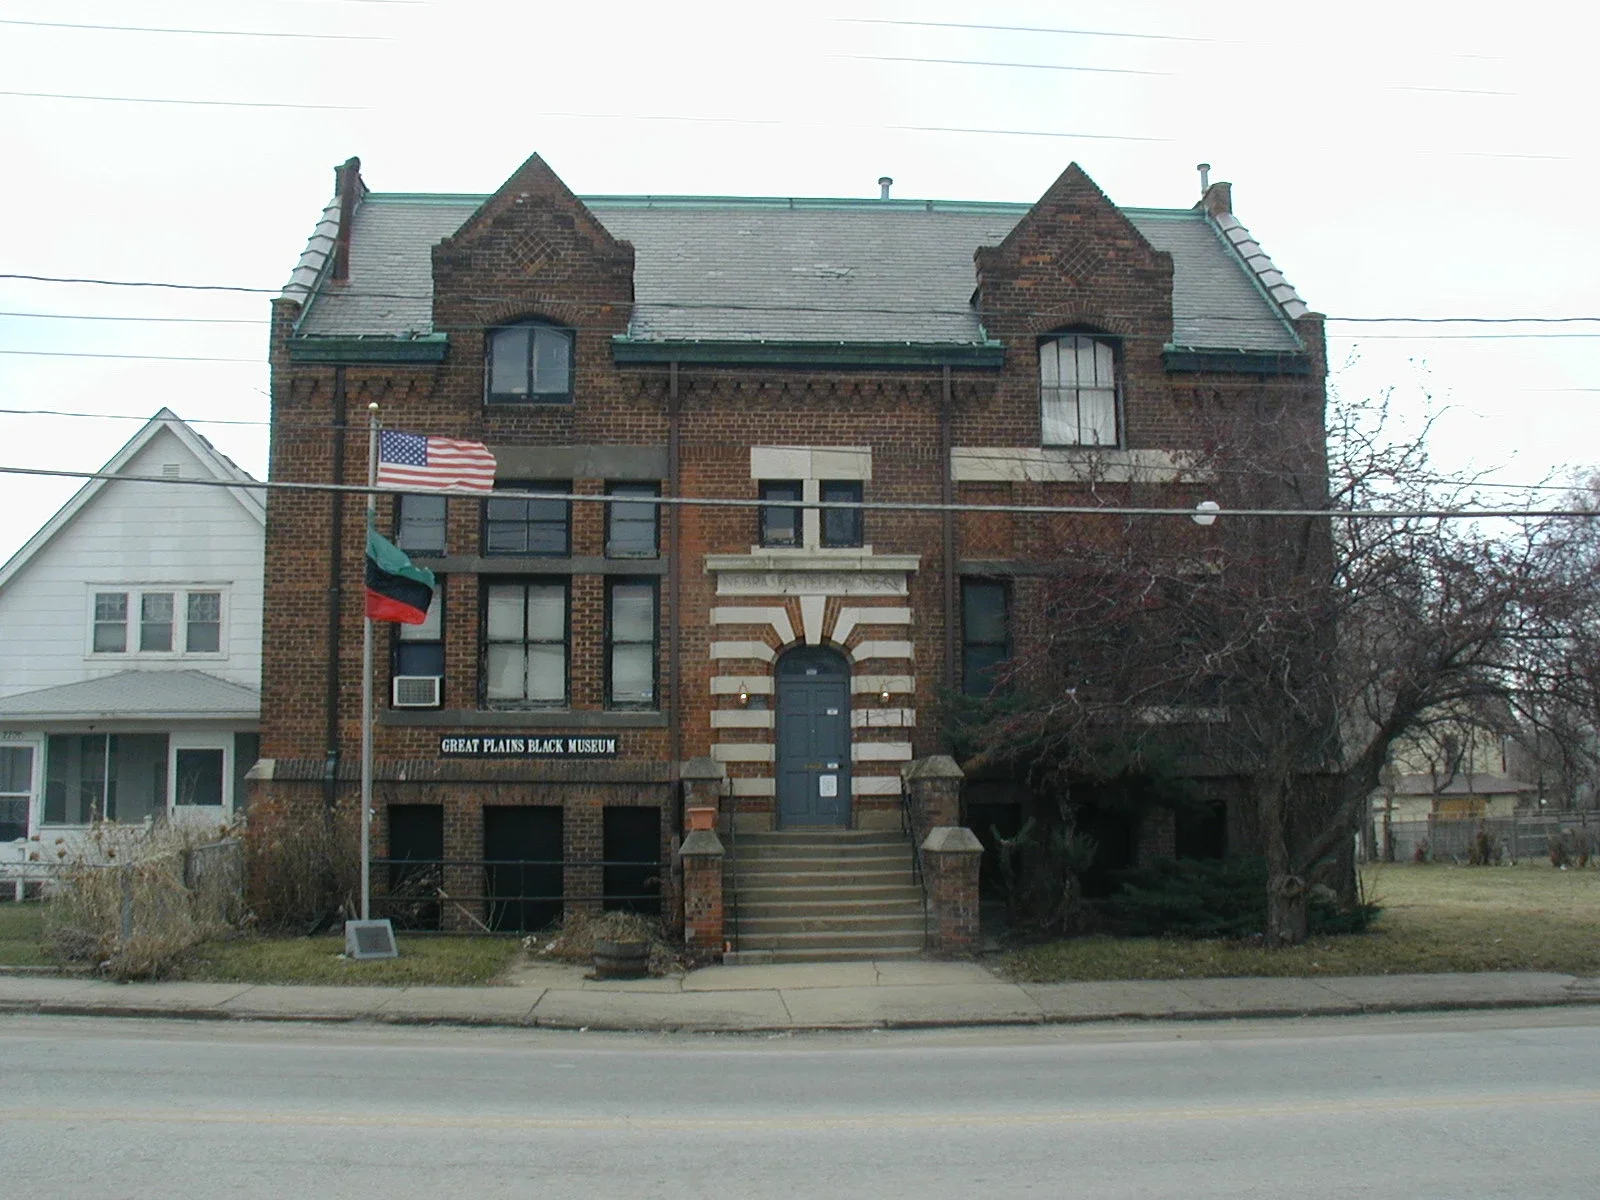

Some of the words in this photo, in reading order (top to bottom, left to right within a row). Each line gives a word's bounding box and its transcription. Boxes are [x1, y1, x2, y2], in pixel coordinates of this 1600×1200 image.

[441, 738, 480, 753] GREAT
[483, 738, 525, 753] PLAINS
[528, 738, 564, 753] BLACK
[568, 738, 616, 753] MUSEUM
